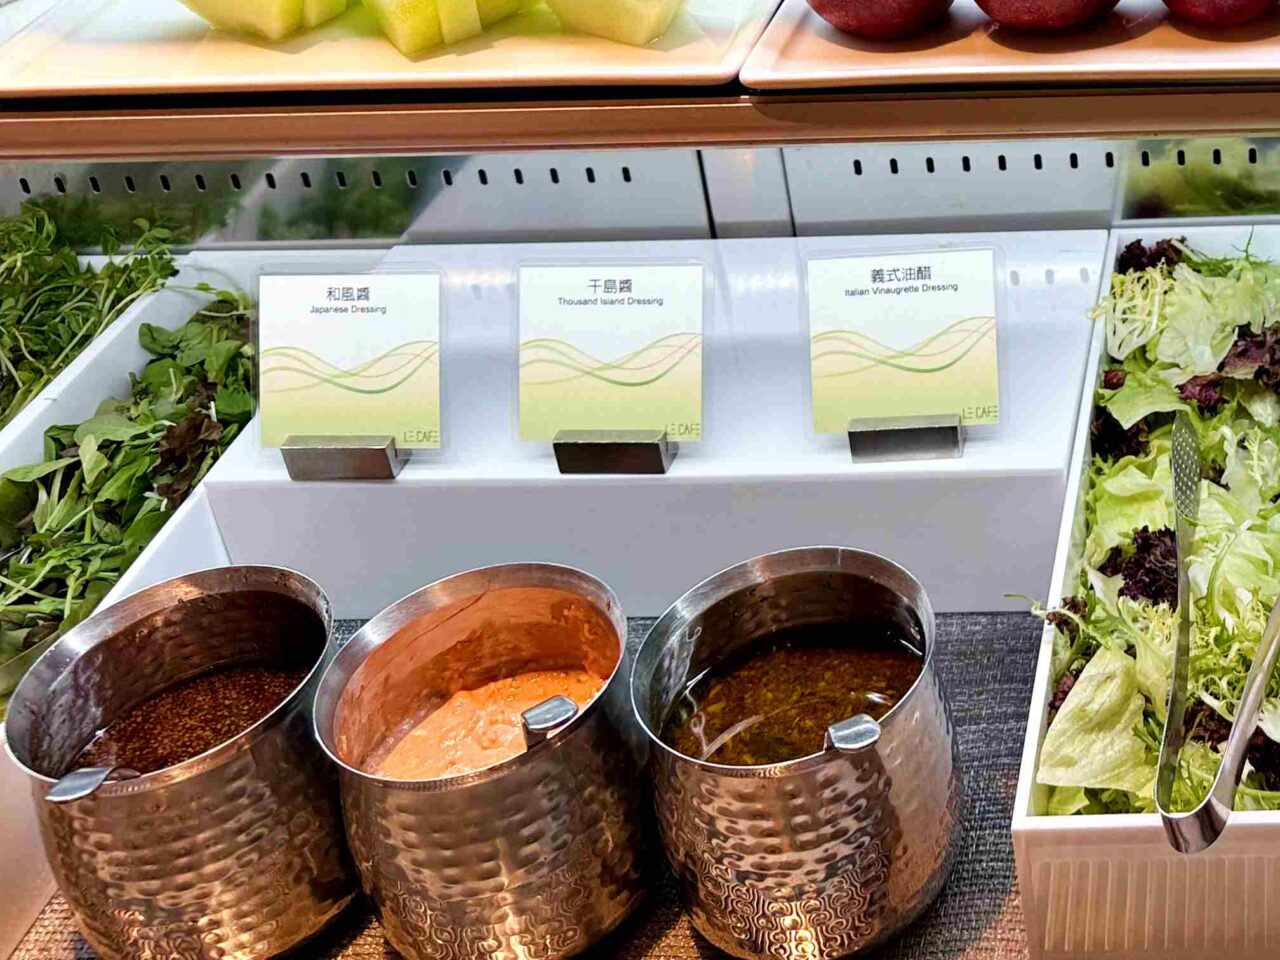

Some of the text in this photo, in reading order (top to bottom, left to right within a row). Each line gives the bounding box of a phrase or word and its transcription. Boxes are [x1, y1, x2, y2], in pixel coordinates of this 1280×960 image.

[871, 266, 932, 284] 義式油醋
[844, 287, 870, 297] Italian
[922, 283, 958, 293] Dressing
[558, 296, 664, 306] Thousand Island Dressing
[309, 304, 387, 315] Japanese Dressing
